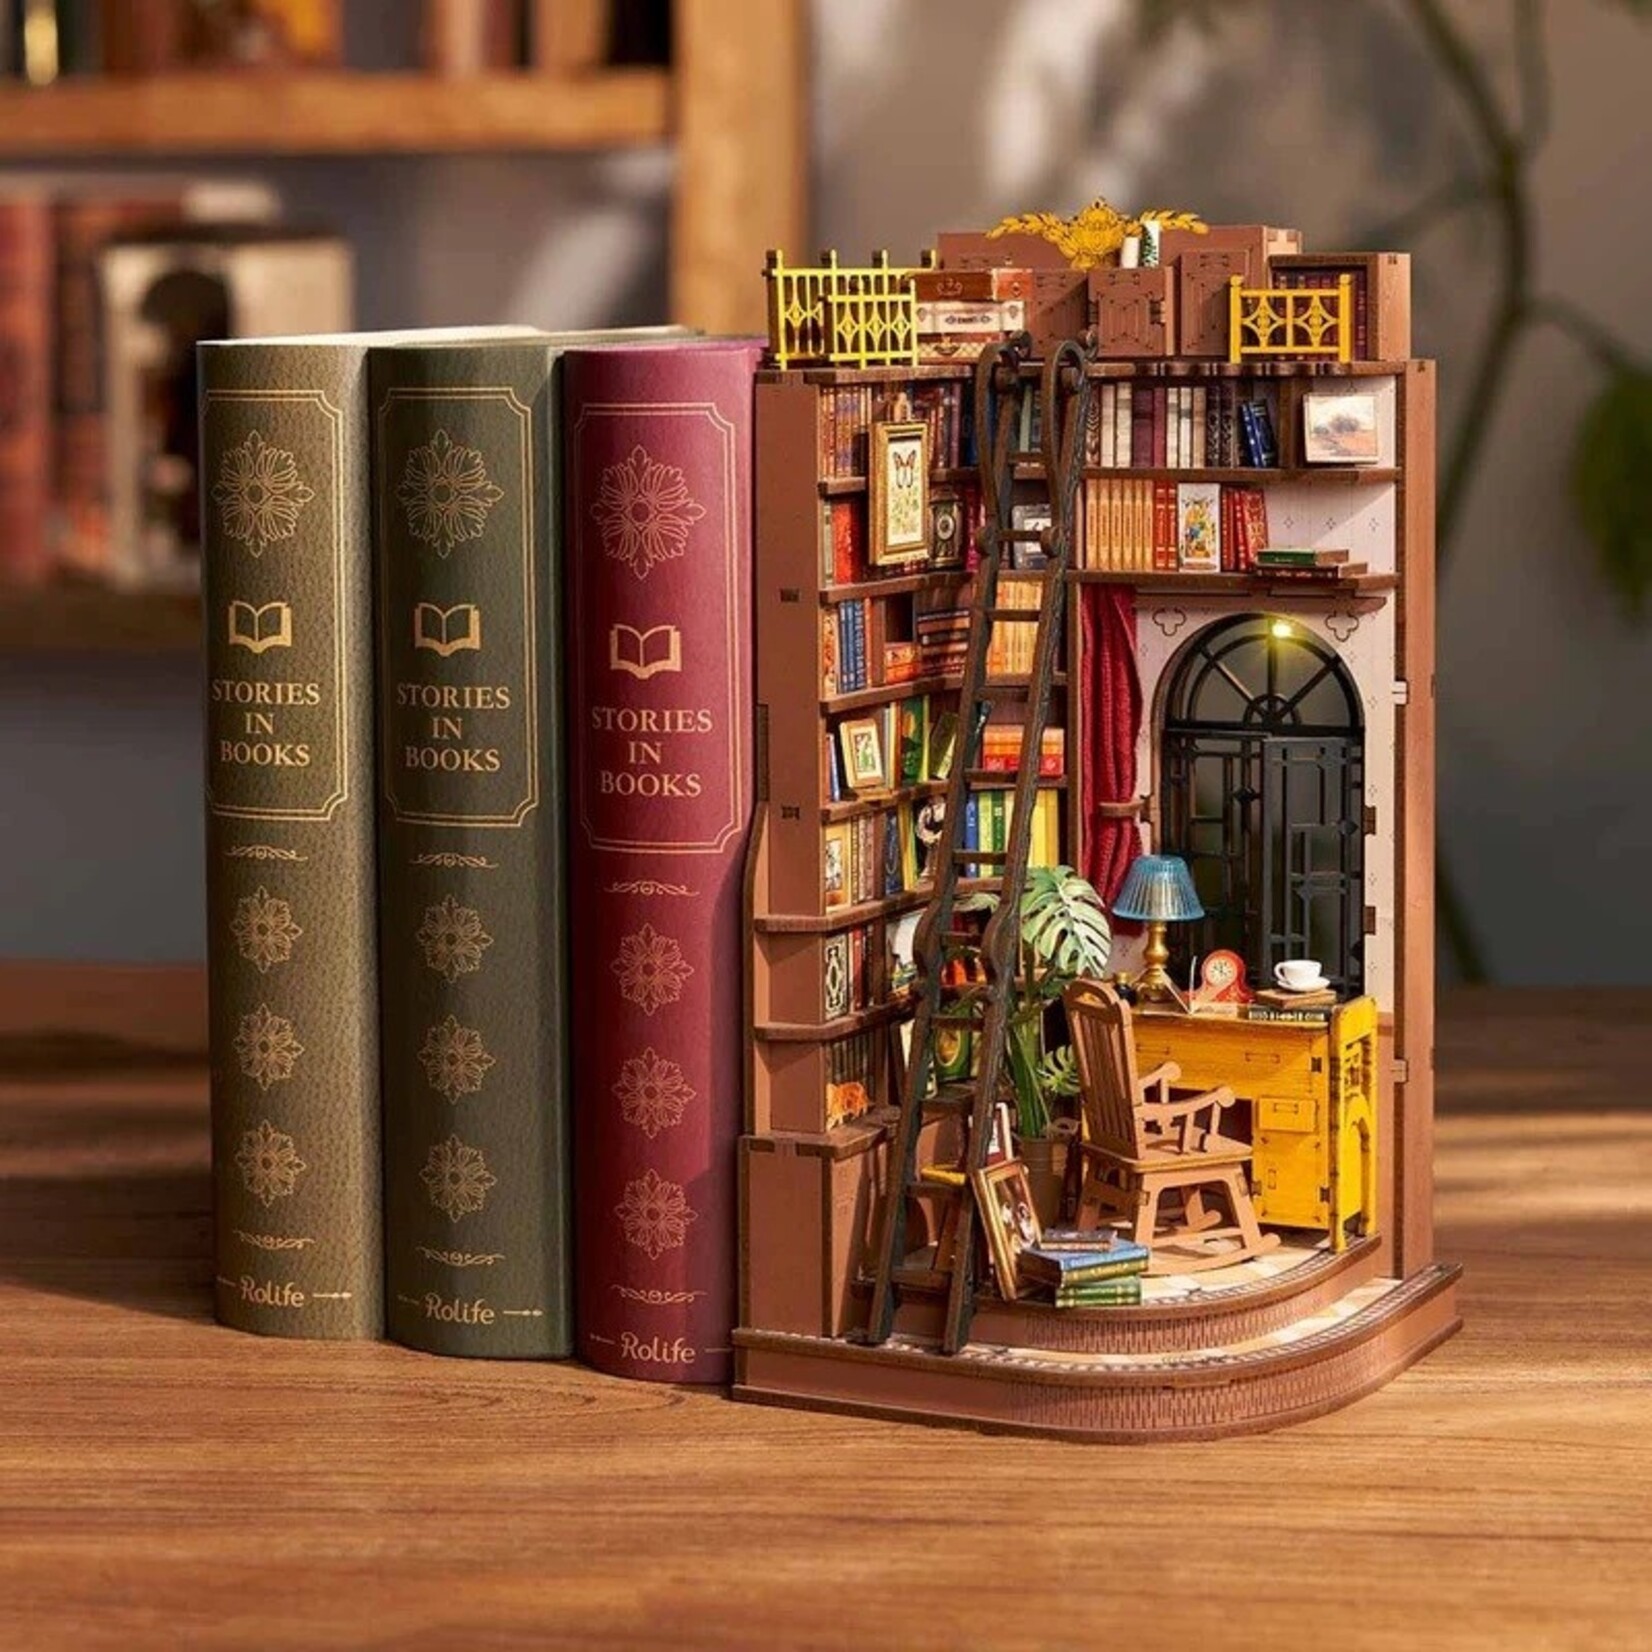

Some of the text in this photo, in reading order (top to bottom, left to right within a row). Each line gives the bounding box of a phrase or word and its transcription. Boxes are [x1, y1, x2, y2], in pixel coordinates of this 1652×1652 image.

[212, 679, 320, 706] STORIES
[397, 683, 511, 709] STORIES
[244, 712, 274, 735] IN
[431, 716, 462, 739] IN
[591, 706, 713, 733] STORIES
[220, 741, 310, 767] BOOKS
[404, 747, 501, 772] BOOKS
[628, 740, 662, 764] IN
[600, 772, 701, 797] BOOKS
[240, 1276, 305, 1308] Rolife
[425, 1293, 495, 1324] Rolife
[620, 1331, 696, 1364] Rolife
